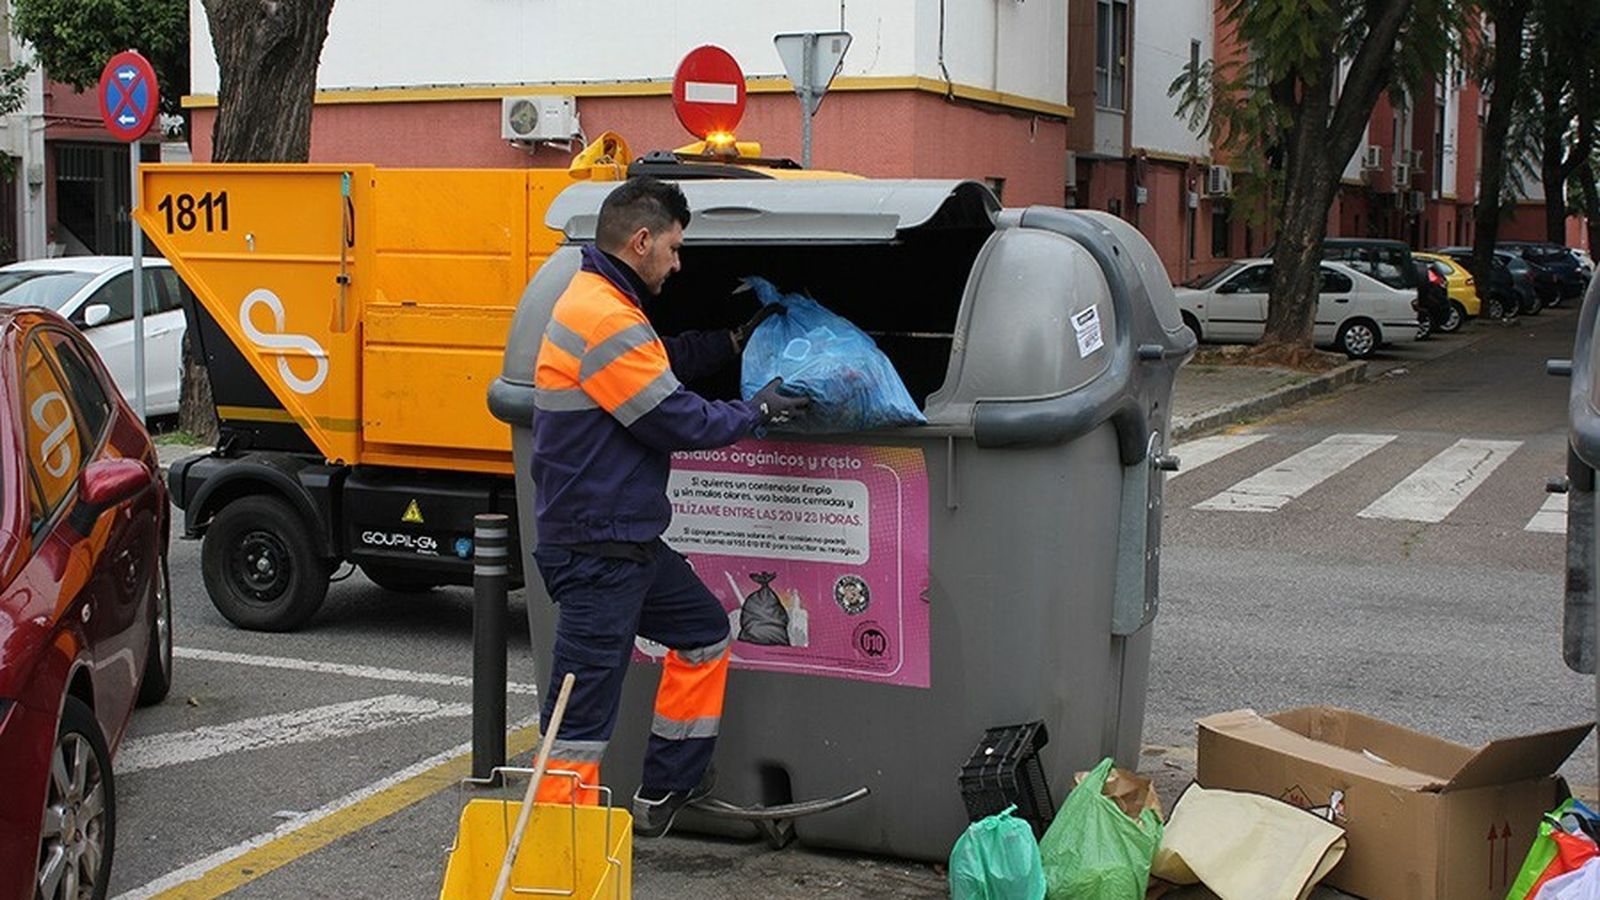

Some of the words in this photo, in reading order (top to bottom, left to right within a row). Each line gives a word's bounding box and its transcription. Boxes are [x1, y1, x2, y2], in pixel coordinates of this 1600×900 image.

[158, 191, 228, 234] 1811
[671, 450, 728, 461] esiduos
[730, 449, 804, 467] orgánicos
[808, 456, 817, 470] y
[821, 455, 861, 469] resto
[673, 489, 680, 497] y
[682, 487, 693, 496] sin
[695, 489, 721, 498] malos
[802, 498, 845, 506] cerradas
[701, 479, 734, 489] quieres
[748, 482, 800, 493] contenedor
[802, 484, 833, 495] limpio
[672, 500, 721, 517] TILÍZAME
[723, 506, 755, 518] ENTRE
[757, 510, 777, 520] LAS
[779, 511, 793, 521] 20
[804, 512, 818, 523] 23
[820, 513, 862, 526] HORAS.
[863, 633, 883, 652] 010
